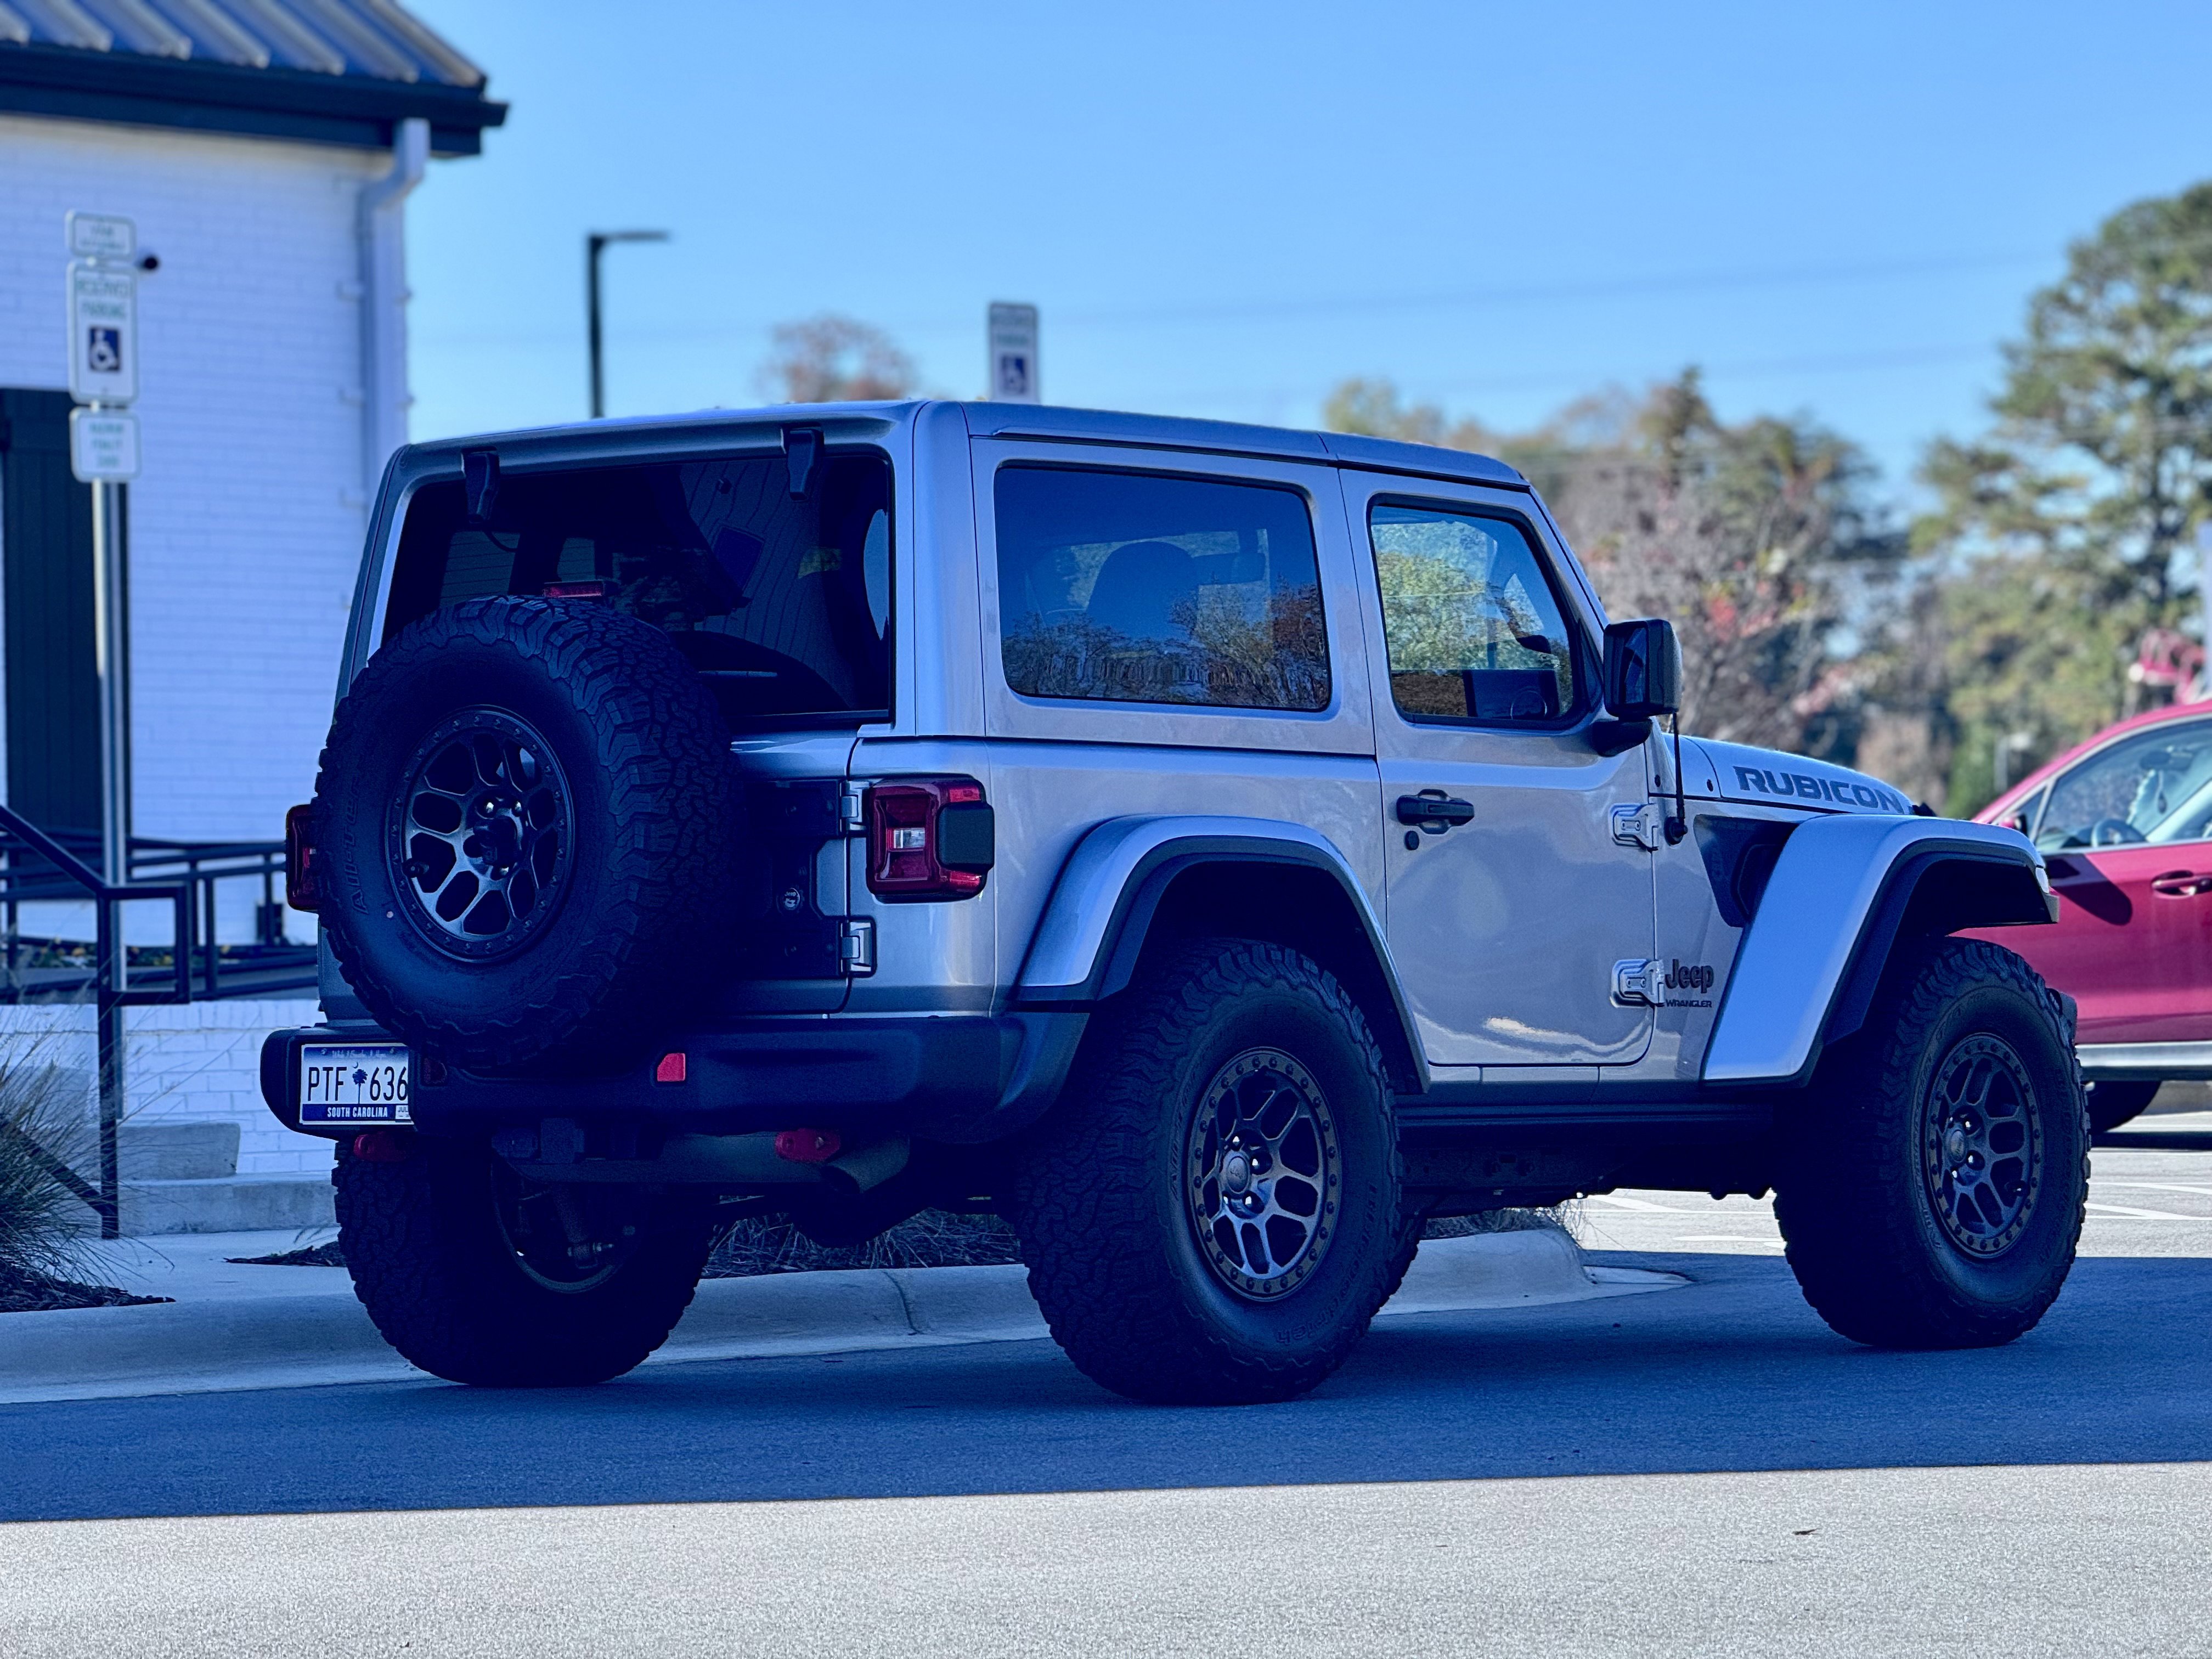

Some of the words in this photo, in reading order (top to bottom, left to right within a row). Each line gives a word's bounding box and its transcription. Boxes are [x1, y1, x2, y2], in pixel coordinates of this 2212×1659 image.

[1732, 766, 1905, 815] RUBICON
[1664, 958, 1714, 994] Jeep
[1666, 999, 1712, 1008] WRANGLER
[307, 1066, 347, 1102] PTF
[369, 1066, 408, 1102] 636
[327, 1107, 351, 1118] SOUTH
[352, 1107, 388, 1118] CAROLINA
